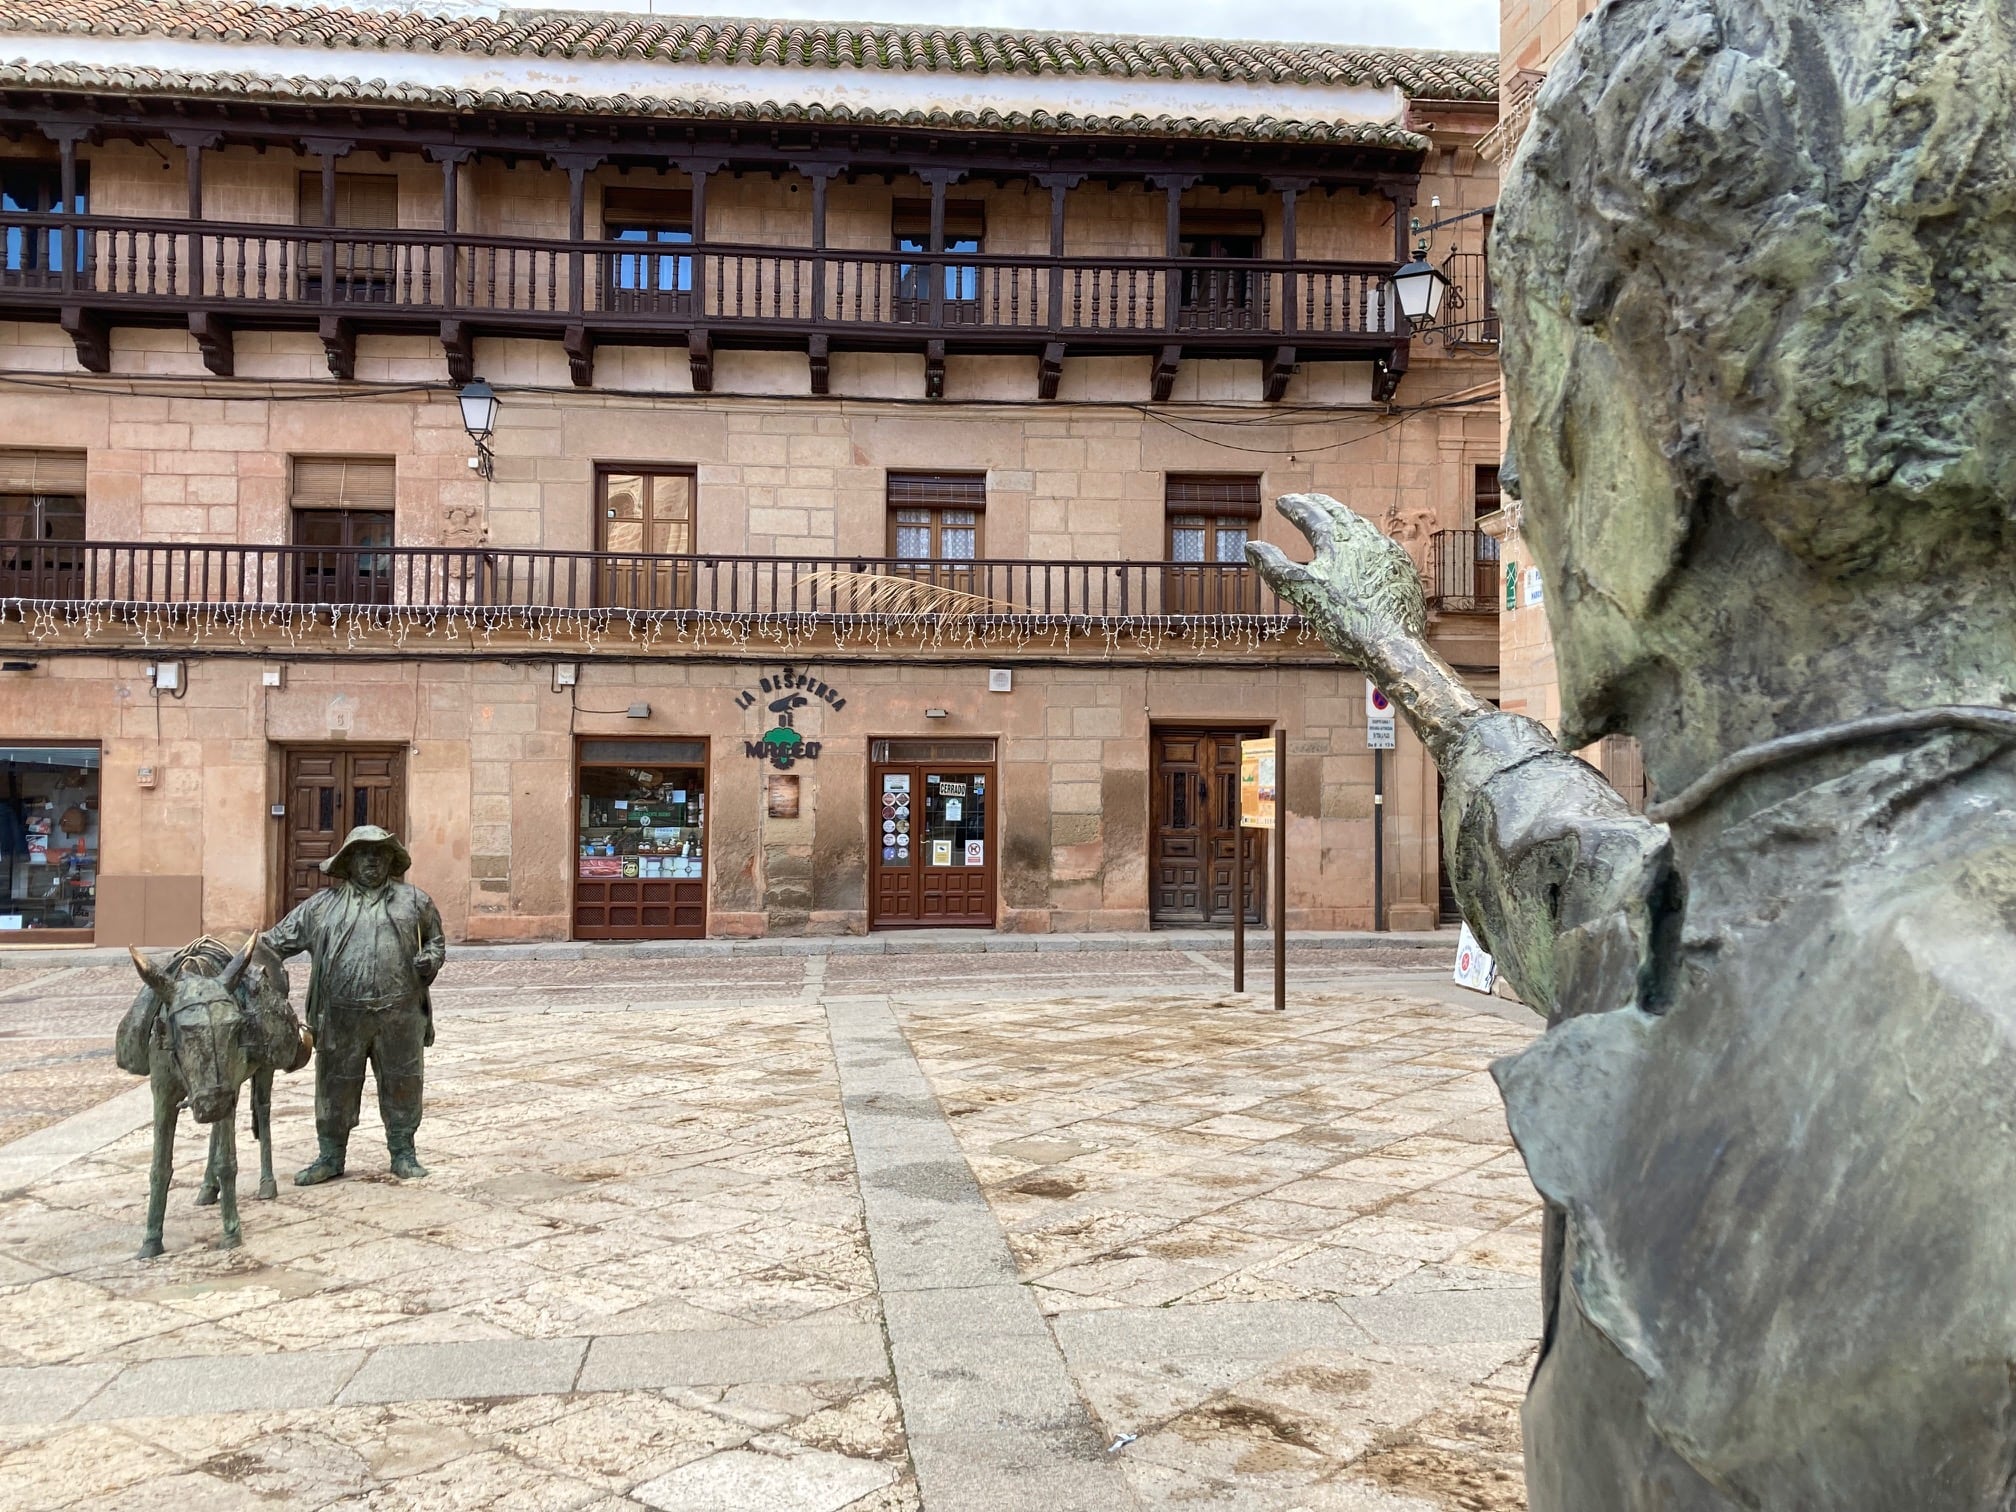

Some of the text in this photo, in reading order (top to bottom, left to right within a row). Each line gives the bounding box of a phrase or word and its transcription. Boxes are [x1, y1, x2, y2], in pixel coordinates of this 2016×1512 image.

[735, 674, 846, 711] LA DESPENSA
[779, 711, 794, 728] DE
[940, 782, 966, 796] CERRADO
